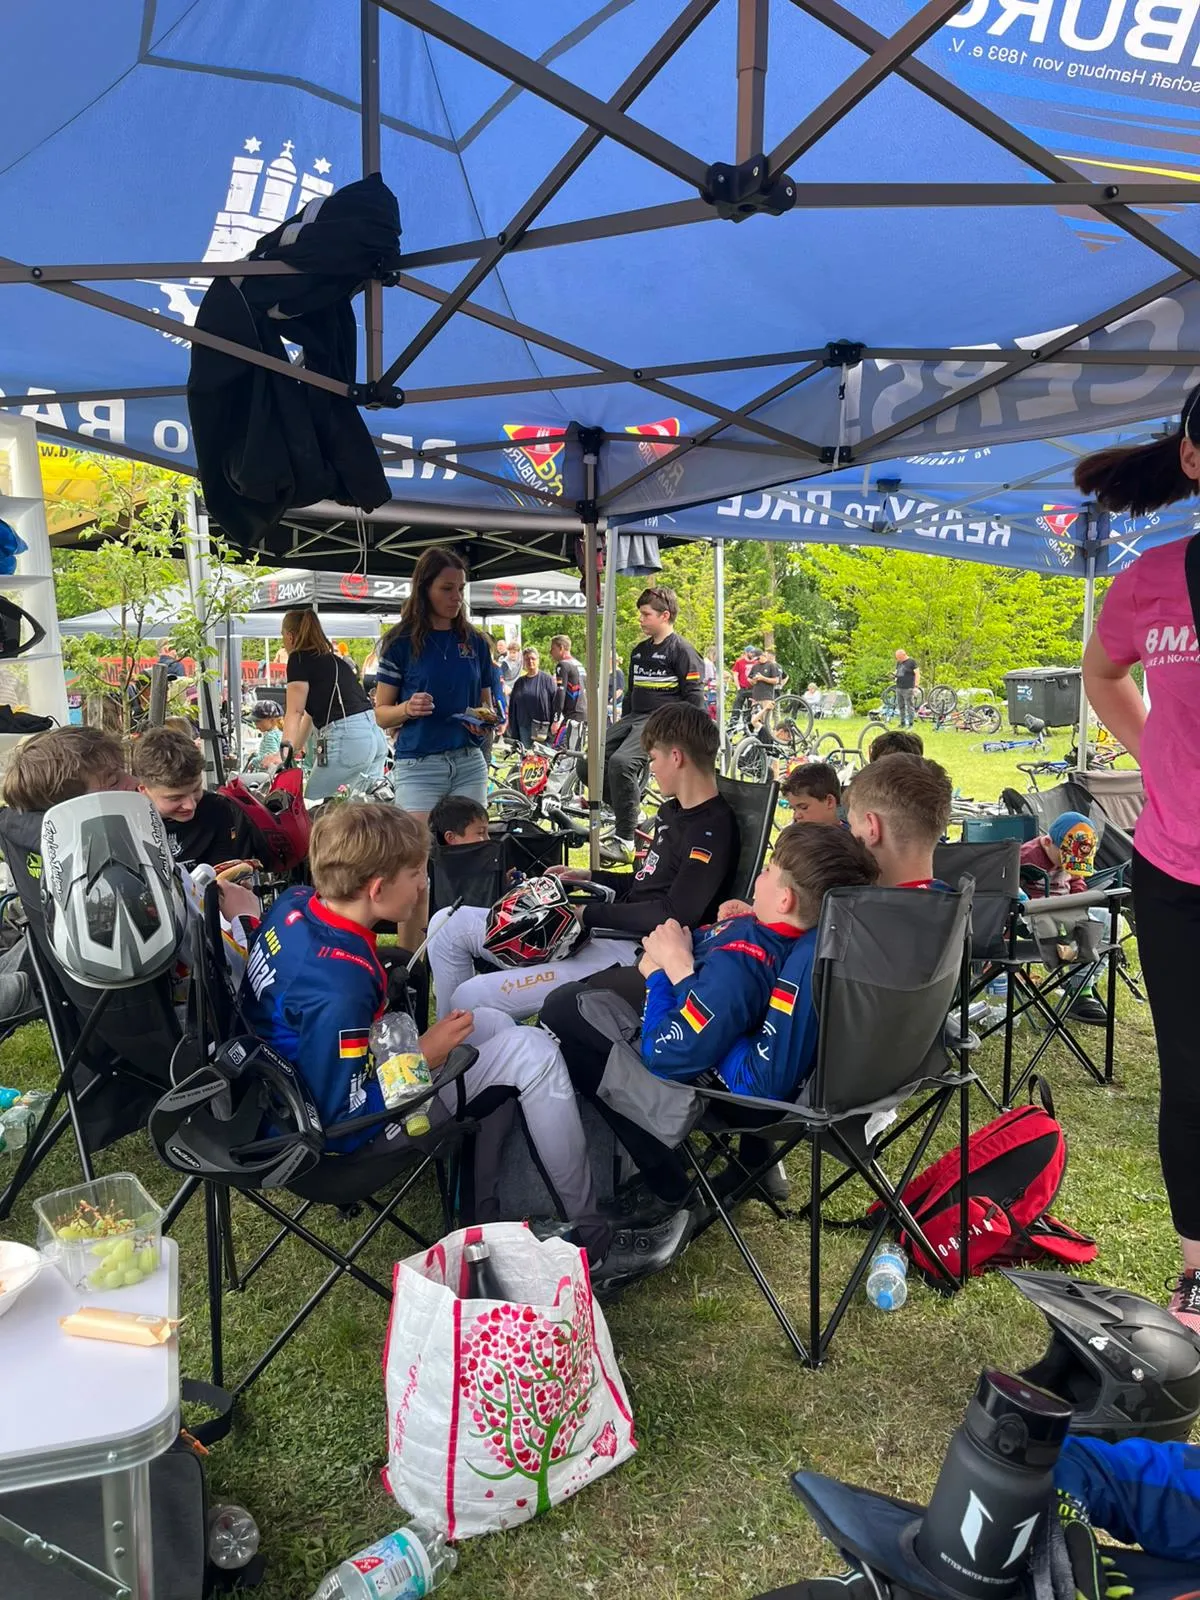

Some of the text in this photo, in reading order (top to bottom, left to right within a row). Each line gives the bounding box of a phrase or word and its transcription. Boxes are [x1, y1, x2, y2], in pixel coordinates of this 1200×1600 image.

[278, 581, 306, 600] 24MX
[524, 766, 544, 780] 1053
[516, 971, 555, 989] LEAD
